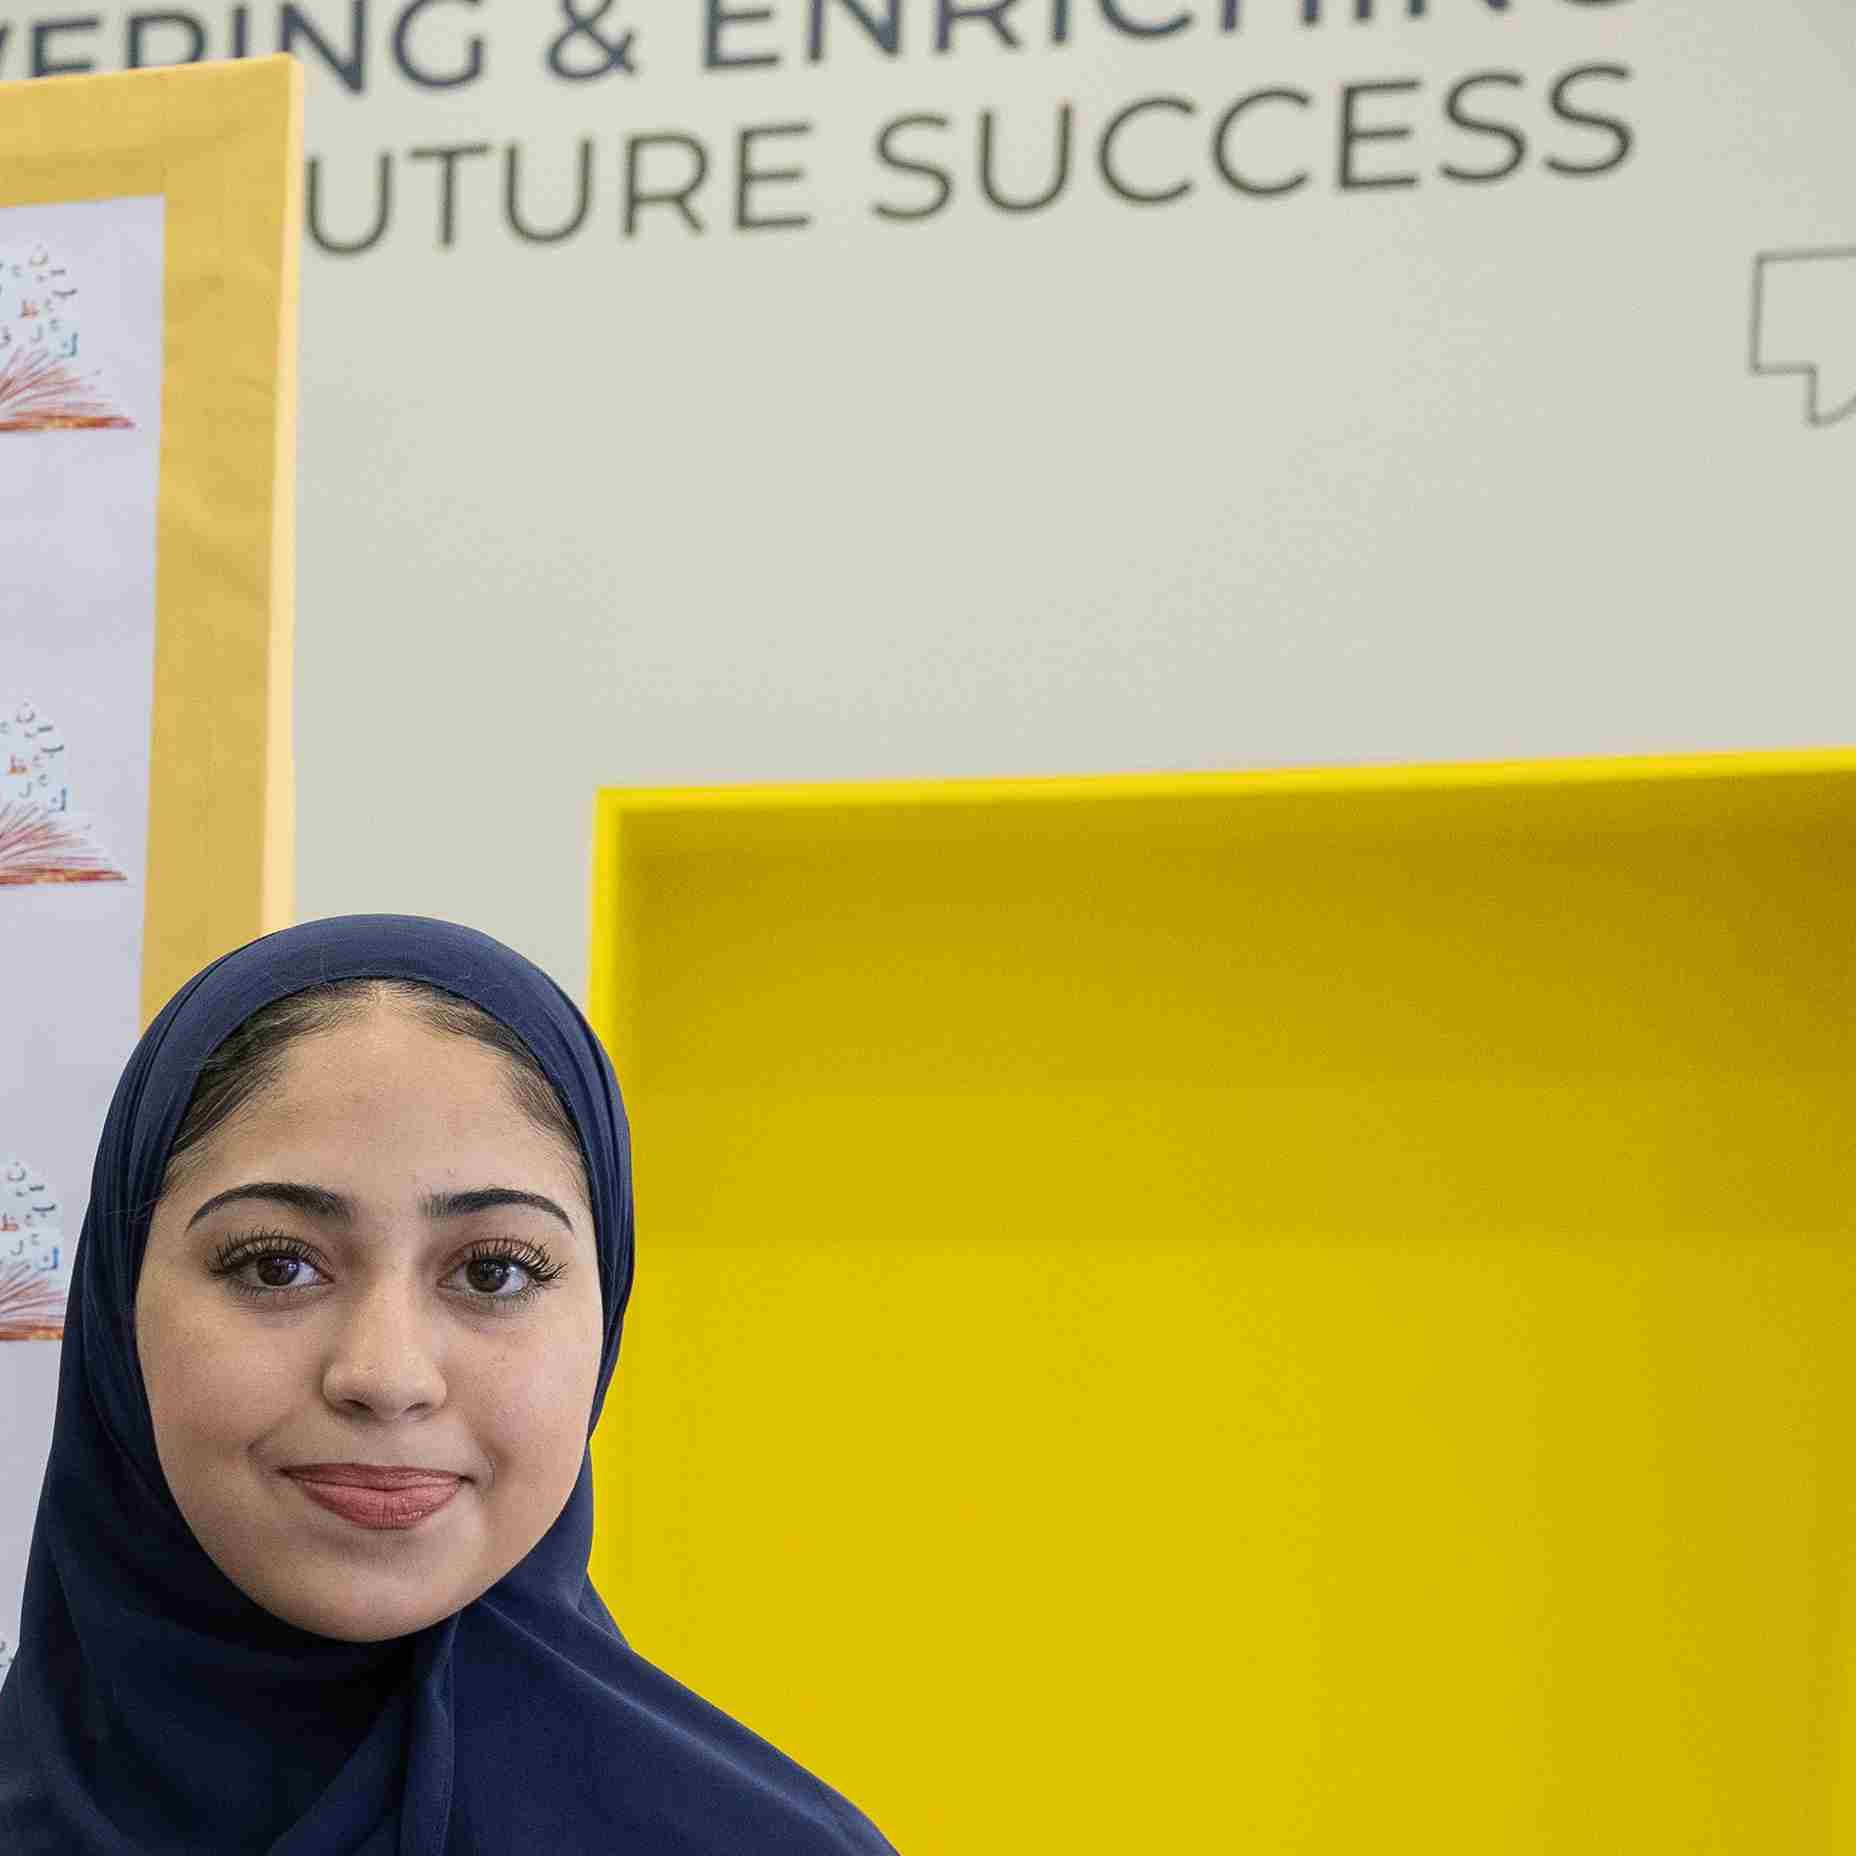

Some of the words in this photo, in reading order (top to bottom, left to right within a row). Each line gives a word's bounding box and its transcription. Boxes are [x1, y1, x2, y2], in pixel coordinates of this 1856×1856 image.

[547, 0, 636, 80] &
[306, 121, 812, 257] UTURE
[871, 62, 1634, 222] SUCCESS
